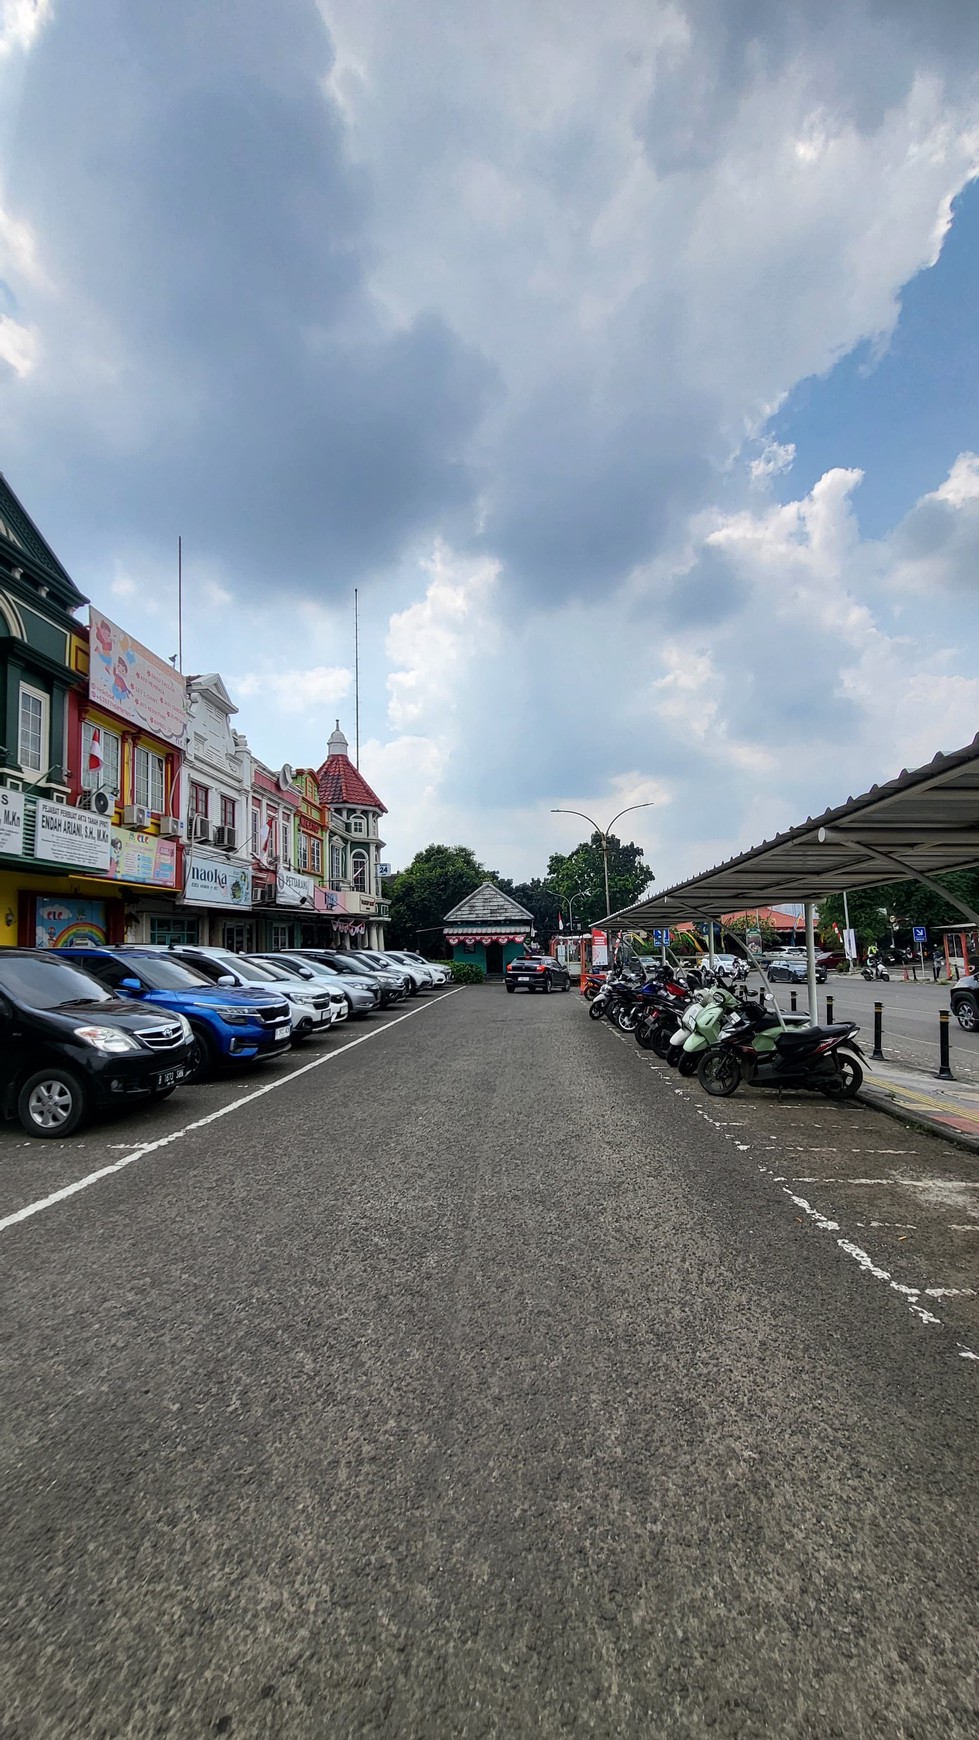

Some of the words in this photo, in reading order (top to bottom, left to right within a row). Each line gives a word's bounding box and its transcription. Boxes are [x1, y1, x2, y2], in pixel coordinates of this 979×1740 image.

[4, 809, 20, 827] M.Kn
[42, 804, 59, 815] PEJABAT
[60, 809, 77, 820] PEMBUAT
[78, 814, 87, 822] AKTA
[87, 816, 98, 825] TANAH
[41, 815, 62, 832] ENDAH
[63, 820, 84, 840] ARIANI,
[137, 834, 149, 844] CLC
[191, 866, 227, 888] naoka
[47, 911, 63, 920] CLC
